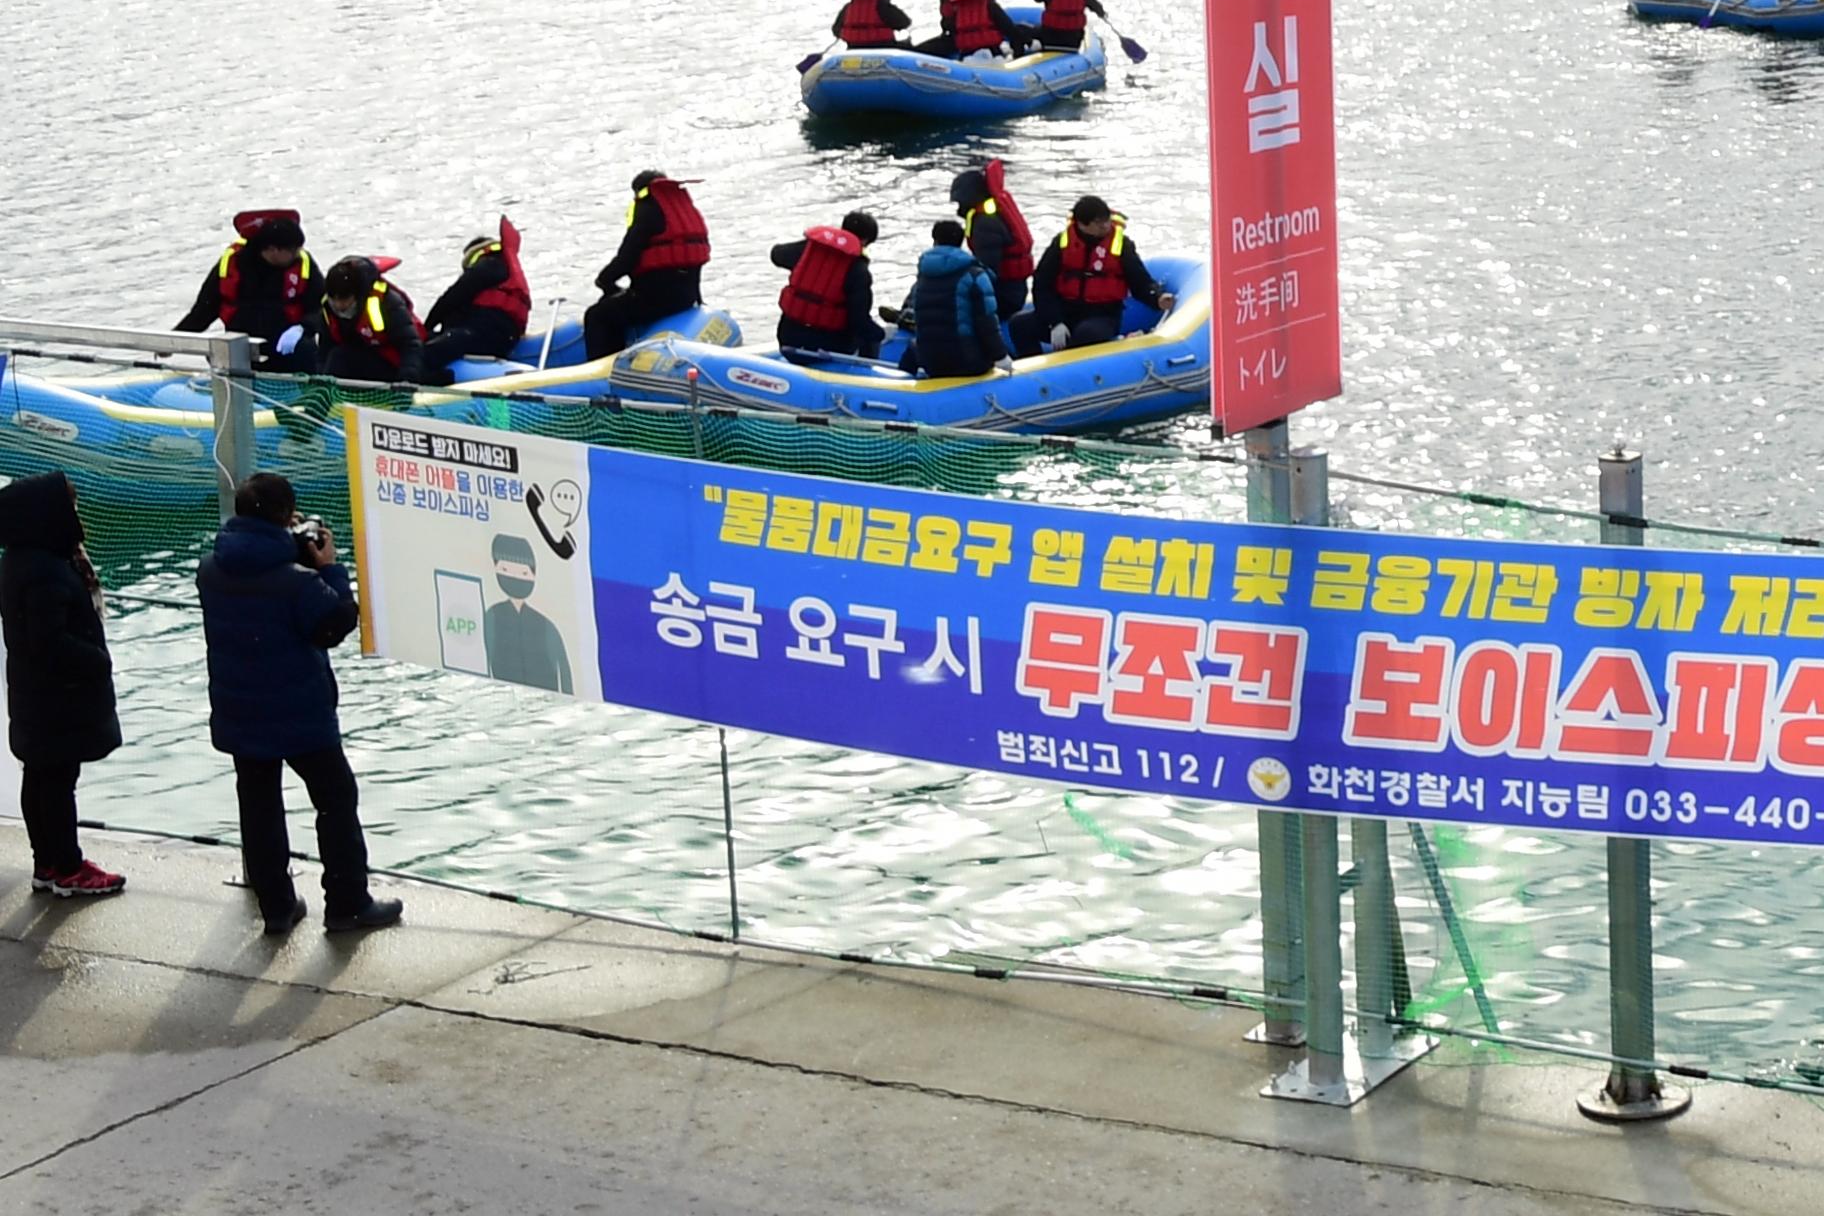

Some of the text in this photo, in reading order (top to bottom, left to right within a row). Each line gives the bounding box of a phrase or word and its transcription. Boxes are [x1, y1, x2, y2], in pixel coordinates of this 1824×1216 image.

[1232, 205, 1320, 254] Restroom
[1235, 270, 1300, 325] 洗手间
[1239, 347, 1287, 392] トイレ
[373, 424, 512, 470] 다운로드 받지 마세요!
[375, 455, 525, 503] 휴대폰 어플을 이용한
[377, 479, 490, 522] 신종 보이스피싱
[704, 484, 1014, 578] "물품대금요구
[1029, 528, 1086, 588] 앱
[1100, 537, 1214, 600] 설치
[1231, 545, 1292, 605] 및
[1310, 549, 1558, 623] 금융기관
[1574, 568, 1704, 632] 빙자
[446, 617, 477, 637] APP
[650, 572, 764, 659] 송금
[786, 596, 905, 680] 요구
[922, 615, 984, 695] 시
[1015, 601, 1309, 741] 무조건
[996, 729, 1122, 777] 범죄신고
[1136, 749, 1199, 784] 112
[1212, 756, 1224, 788] /
[1308, 763, 1486, 812] 화천경찰서
[1500, 777, 1611, 821] 지능팀
